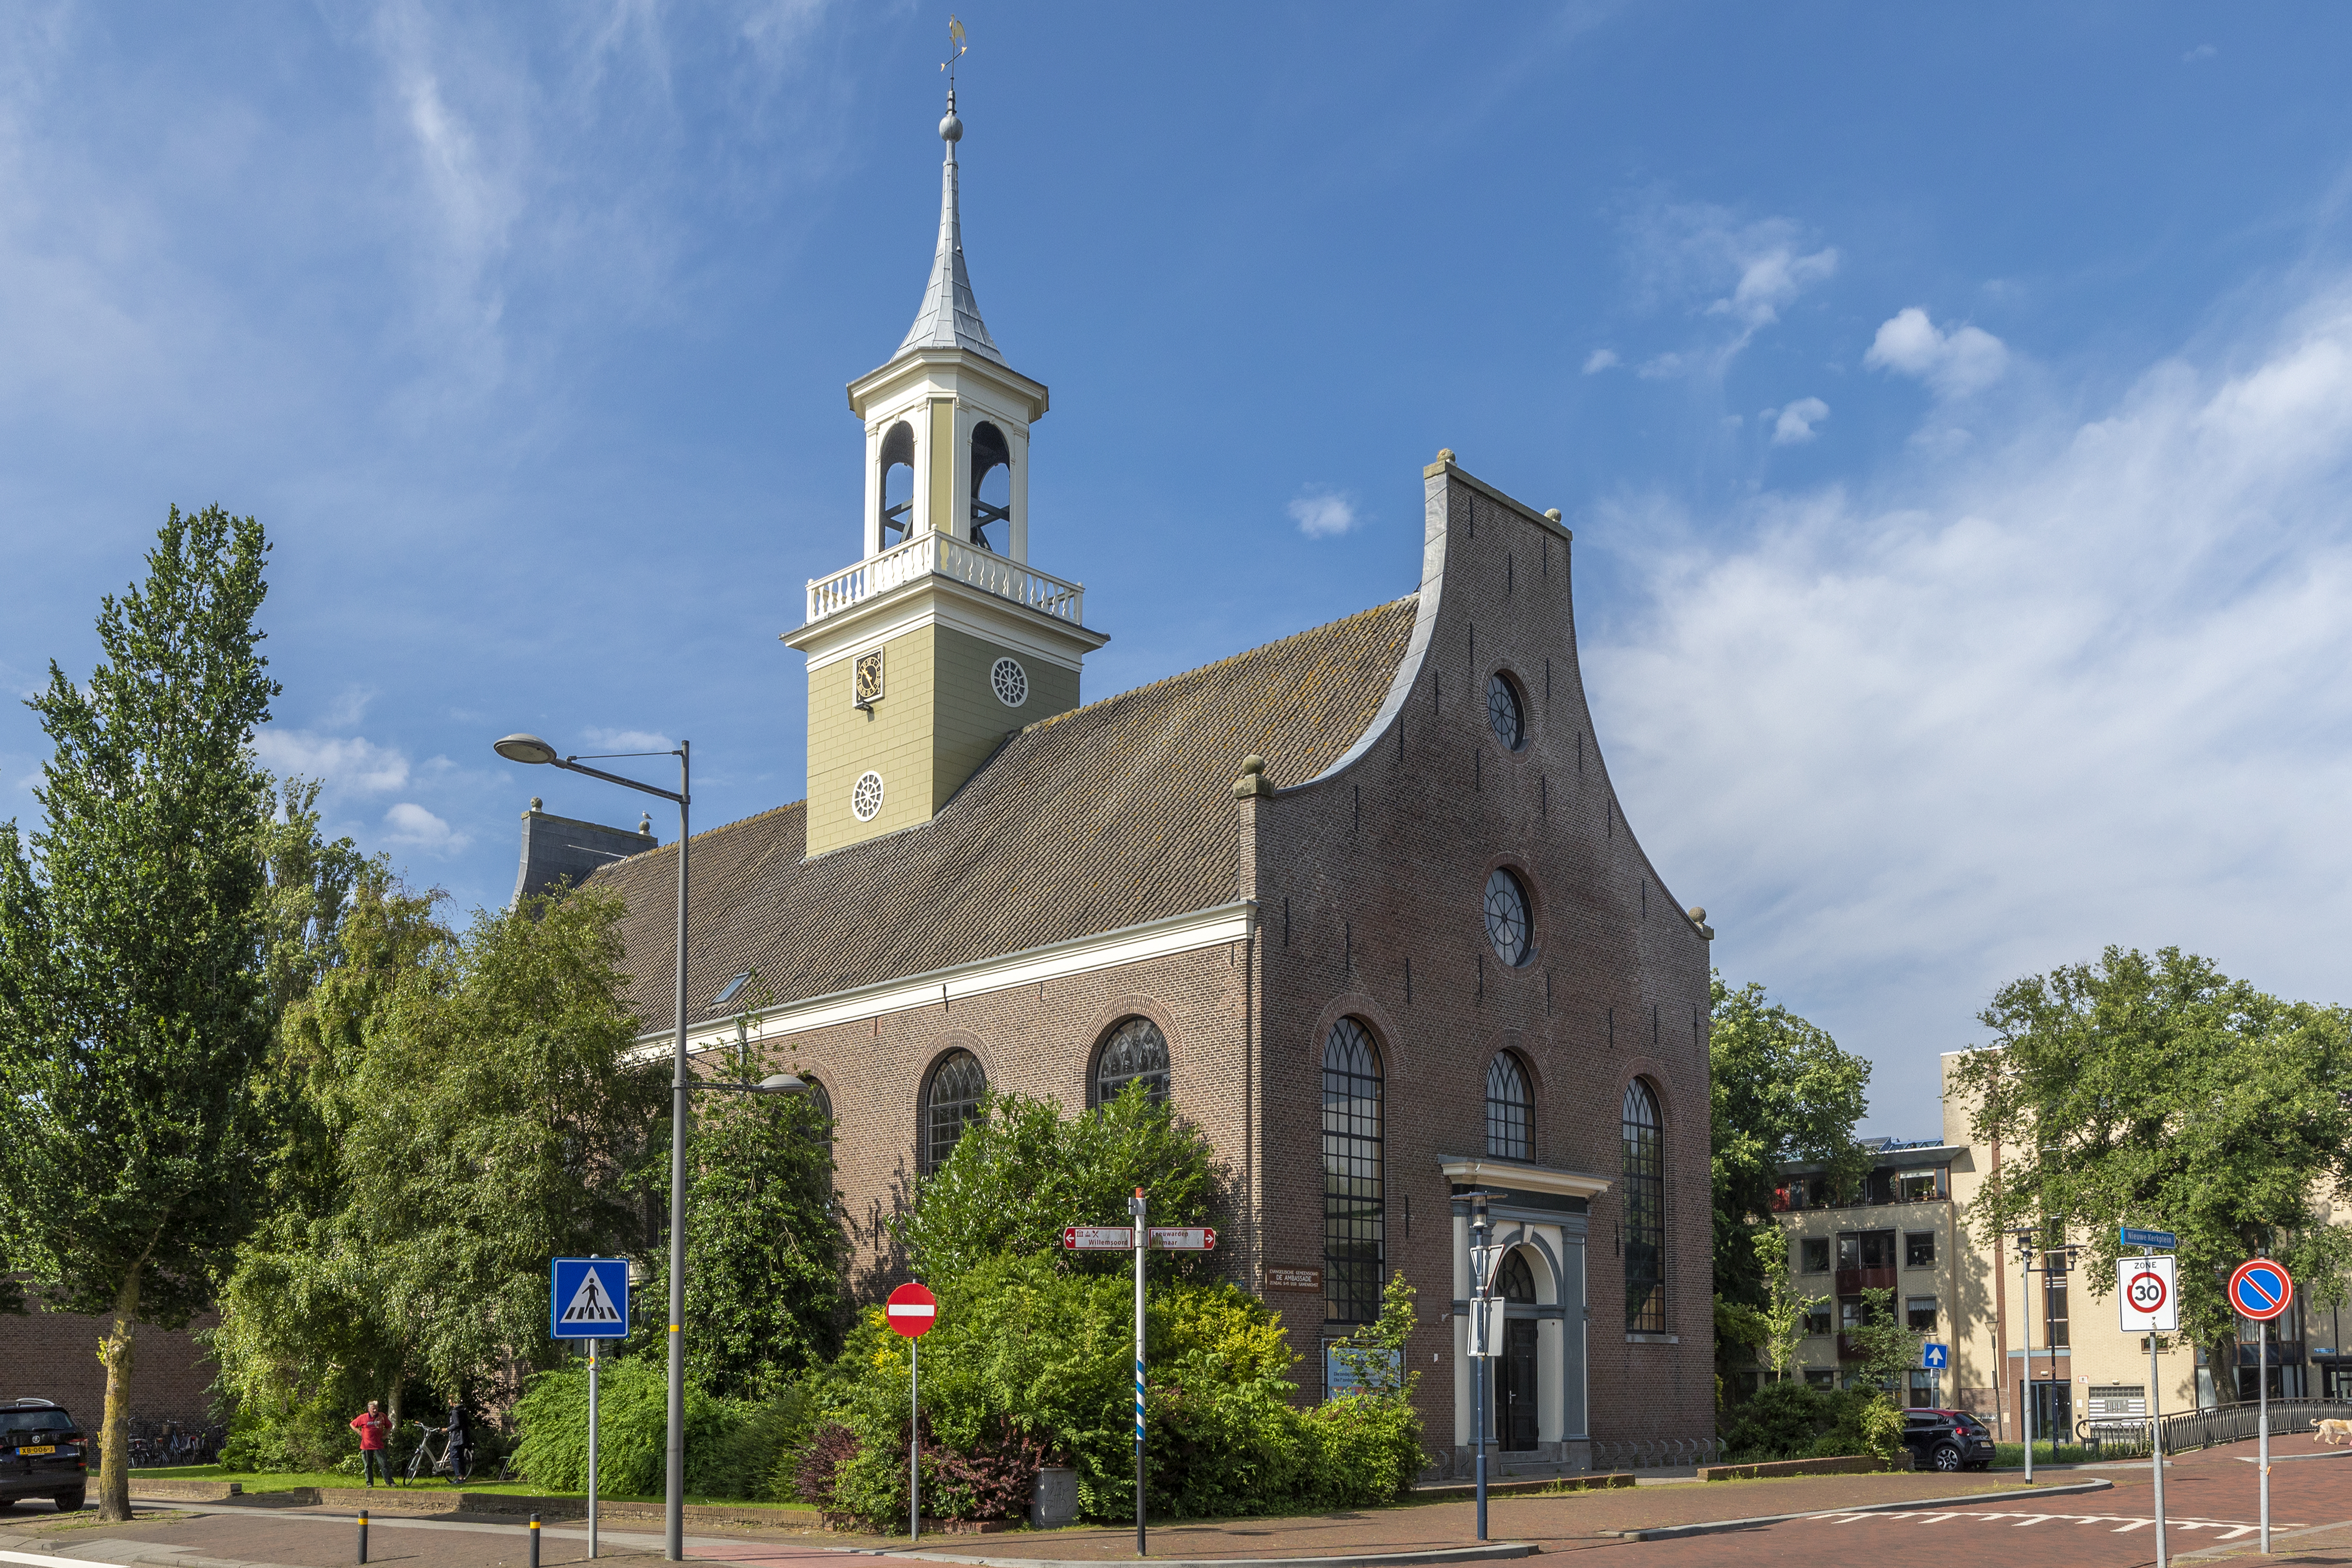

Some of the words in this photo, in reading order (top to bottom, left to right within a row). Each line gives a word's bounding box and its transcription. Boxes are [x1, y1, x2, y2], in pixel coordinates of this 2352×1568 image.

[2128, 1231, 2147, 1241] Nieuwe
[2148, 1234, 2172, 1244] Kerkplein
[2135, 1285, 2159, 1301] 30
